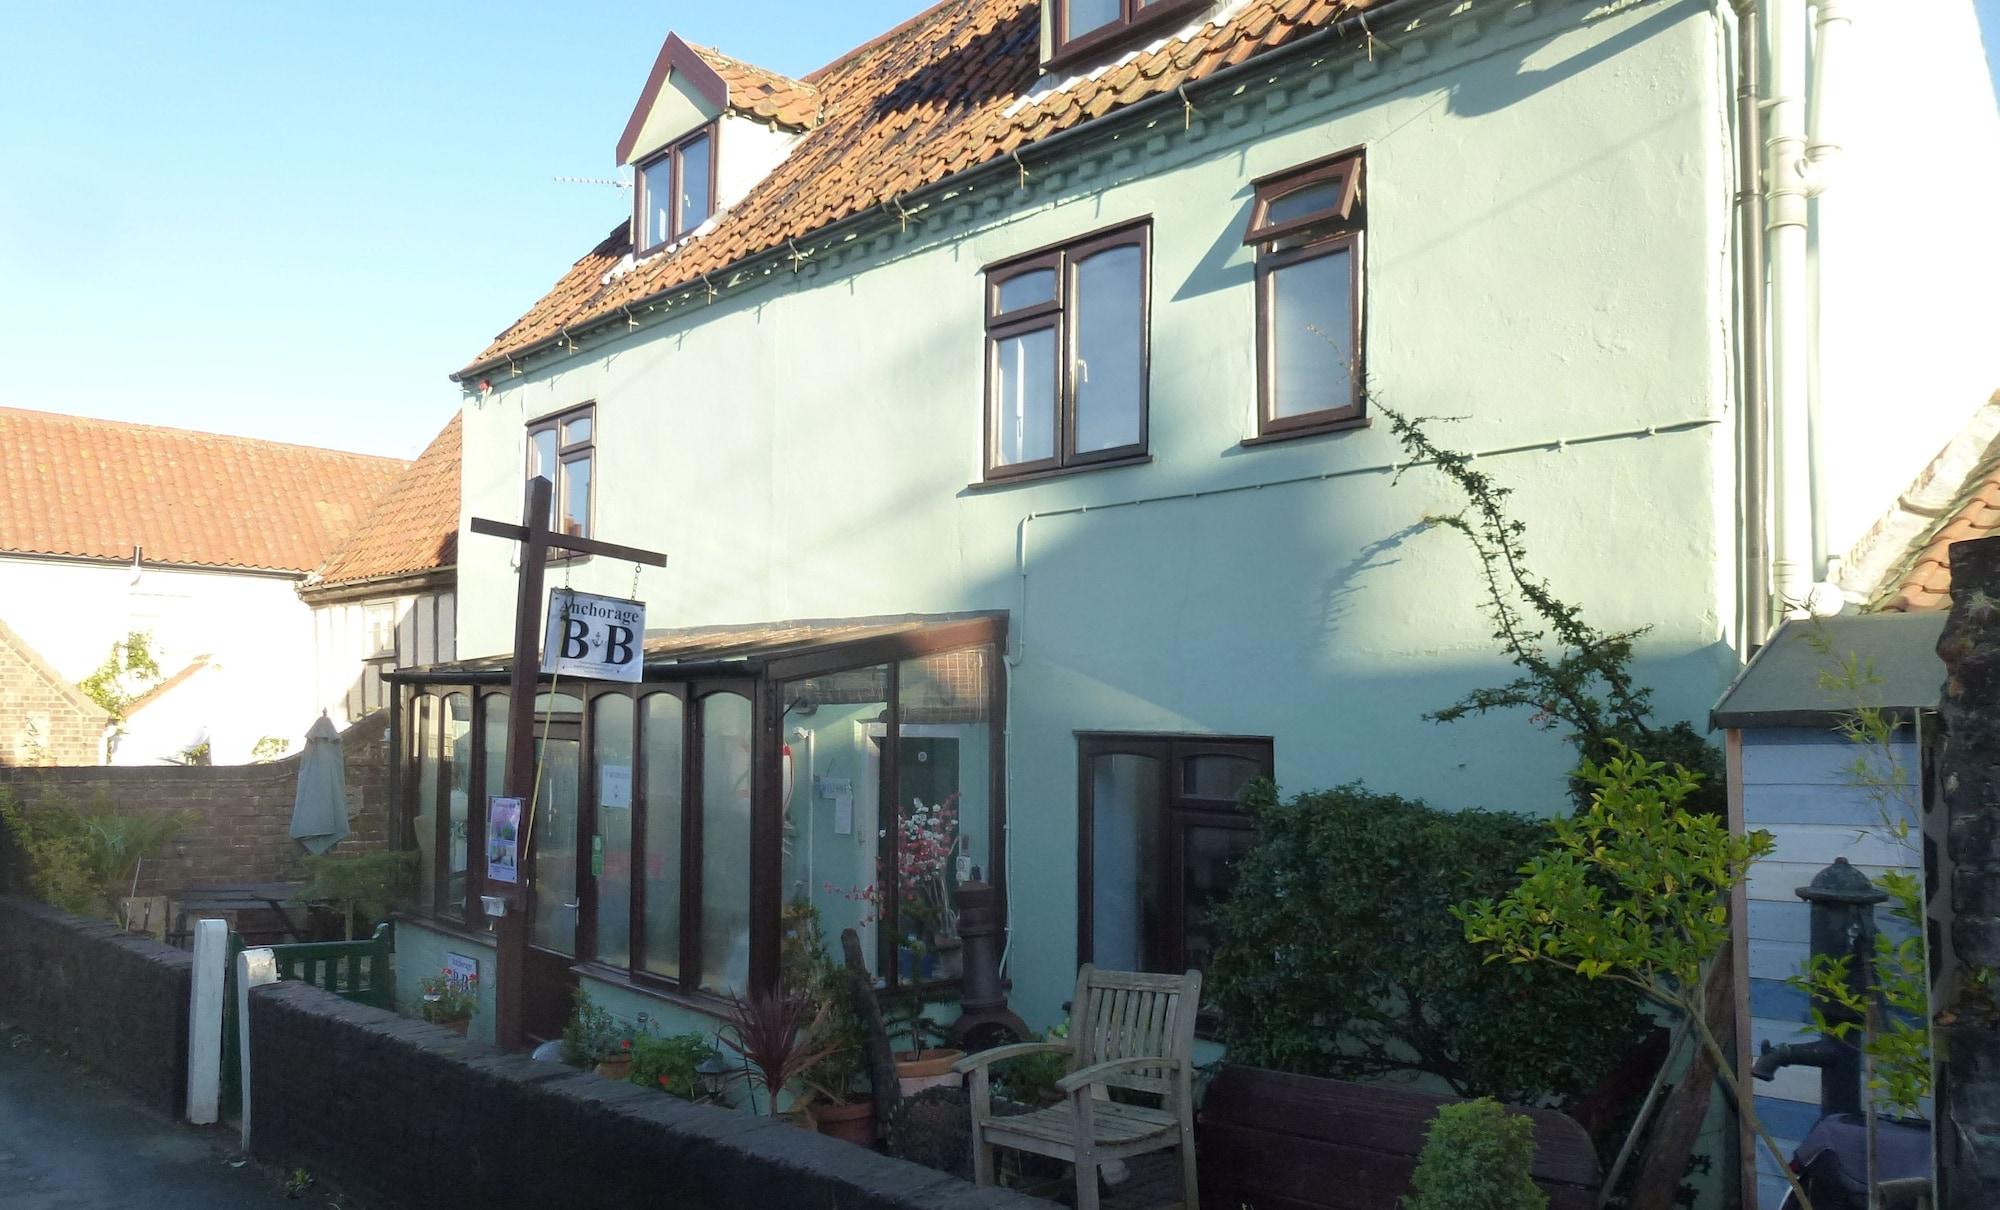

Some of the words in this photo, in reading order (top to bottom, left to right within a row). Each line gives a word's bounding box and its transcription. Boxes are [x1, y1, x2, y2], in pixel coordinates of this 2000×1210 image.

[560, 599, 639, 625] Anchorage
[558, 618, 589, 659] B
[602, 625, 634, 664] B
